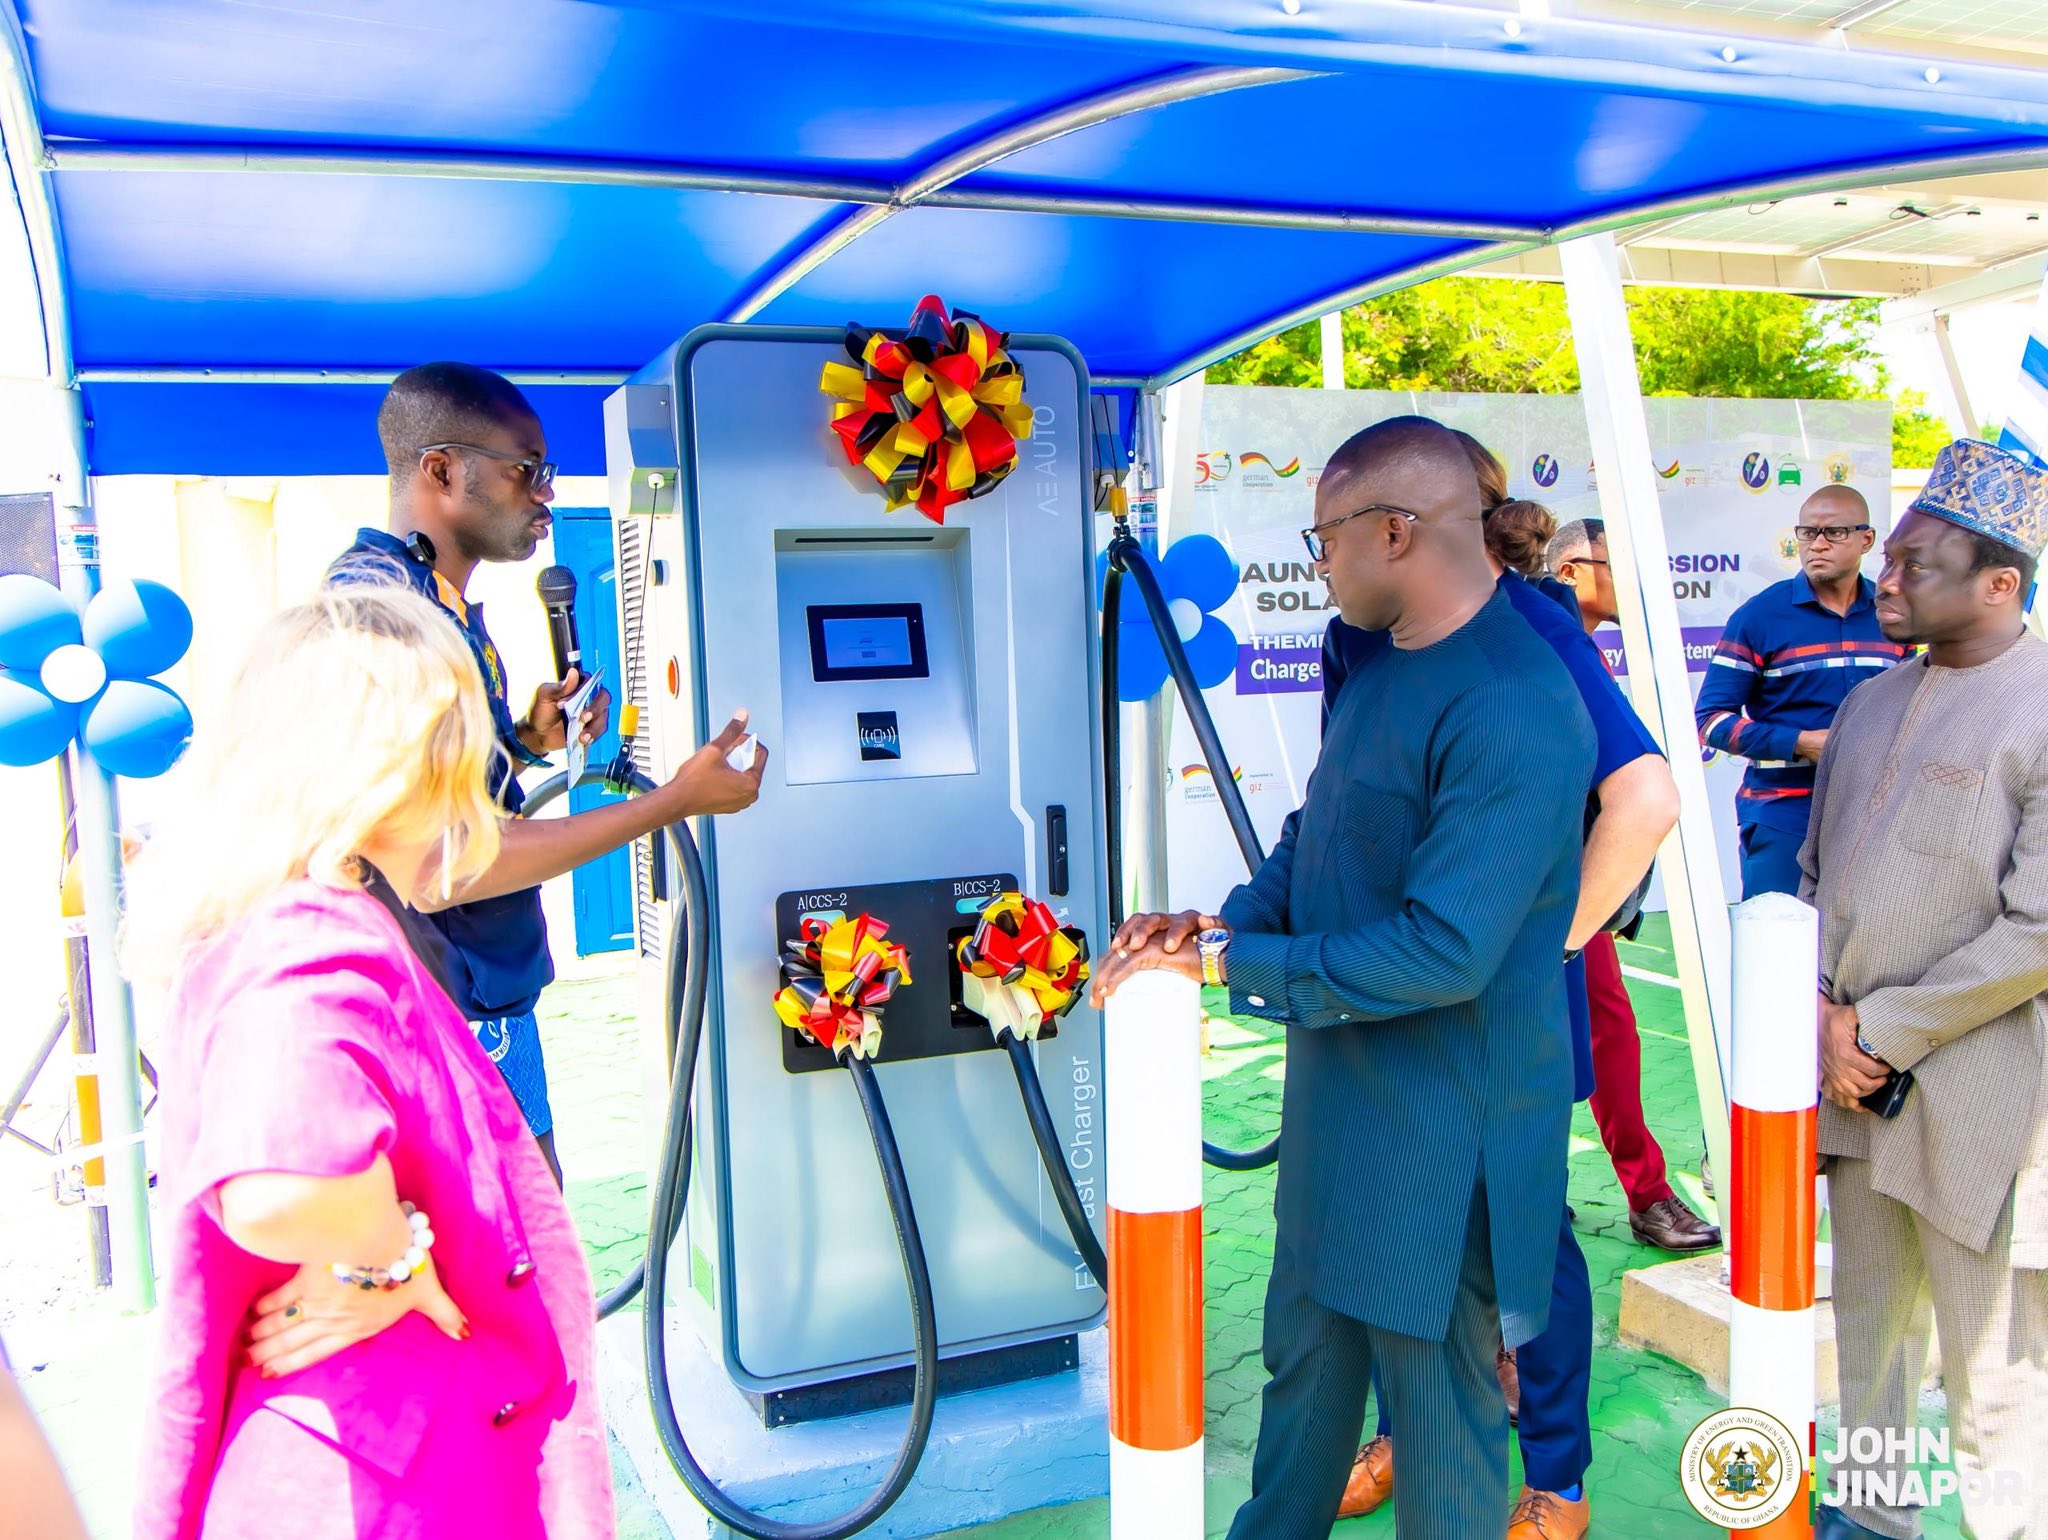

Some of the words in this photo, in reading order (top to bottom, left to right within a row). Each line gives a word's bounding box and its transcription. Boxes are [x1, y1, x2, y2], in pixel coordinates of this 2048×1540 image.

[1239, 562, 1329, 584] AUN
[1673, 580, 1711, 600] ON
[1256, 591, 1340, 613] SOLA
[1603, 647, 1624, 667] gy
[1250, 658, 1321, 683] Charge
[1184, 784, 1211, 794] german
[1070, 1055, 1097, 1170] Charger
[1075, 1176, 1096, 1220] ast
